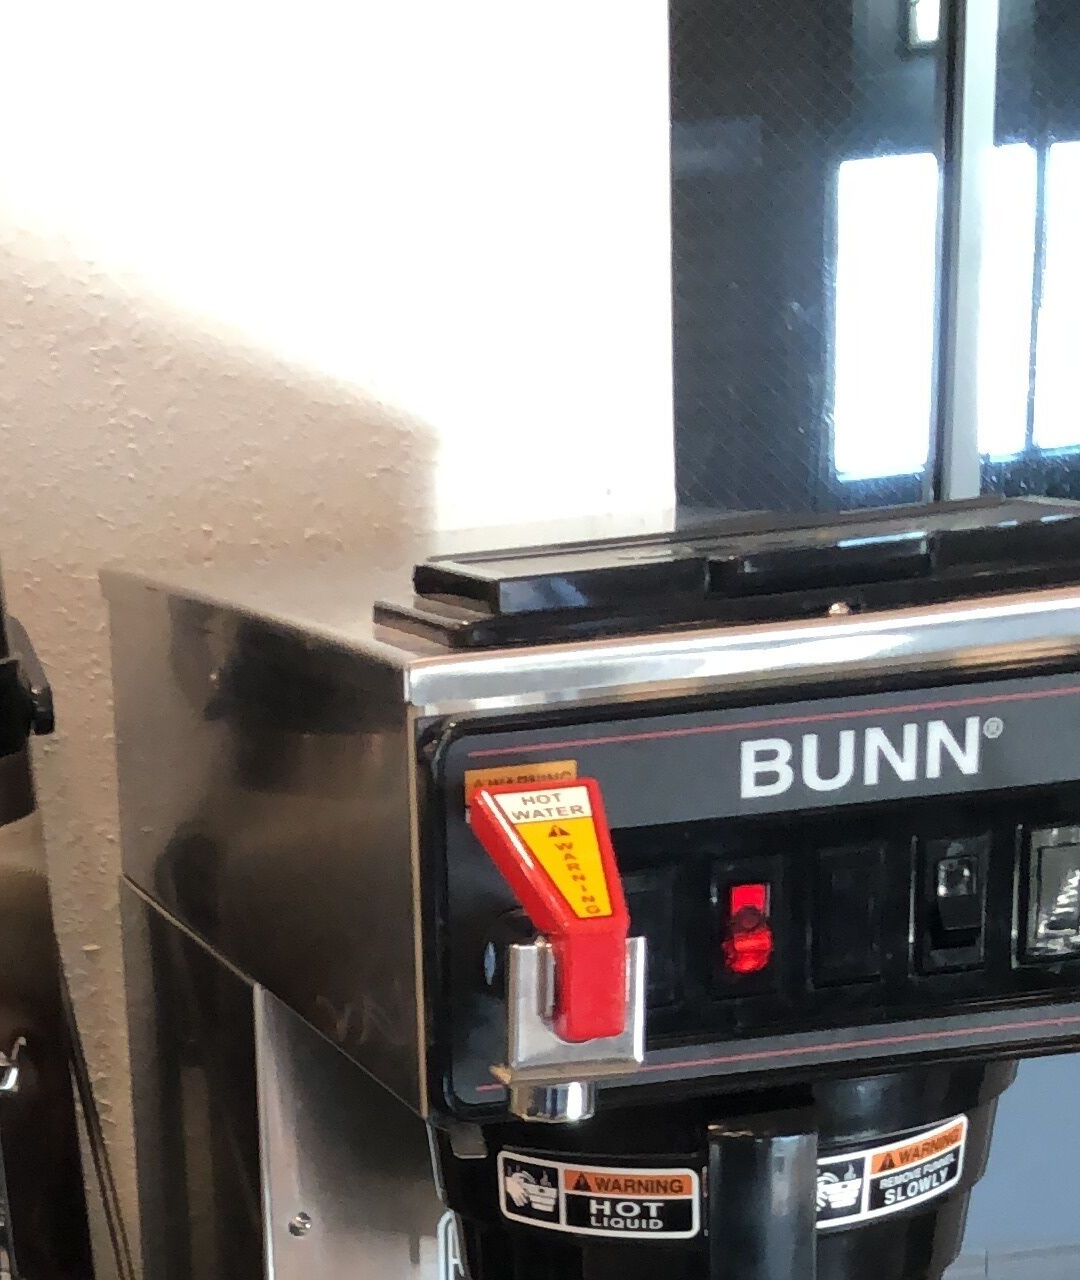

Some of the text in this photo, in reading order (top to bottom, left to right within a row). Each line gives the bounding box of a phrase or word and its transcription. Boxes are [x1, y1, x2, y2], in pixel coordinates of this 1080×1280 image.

[521, 792, 561, 806] HOT
[511, 804, 585, 821] WATER
[555, 842, 601, 915] WARNING
[899, 1128, 961, 1165] WARNING
[594, 1176, 684, 1194] WARNING
[880, 1167, 922, 1190] REMOVE
[884, 1167, 949, 1206] SLOWLY
[589, 1199, 665, 1218] HOT
[590, 1217, 664, 1230] LIQUID
